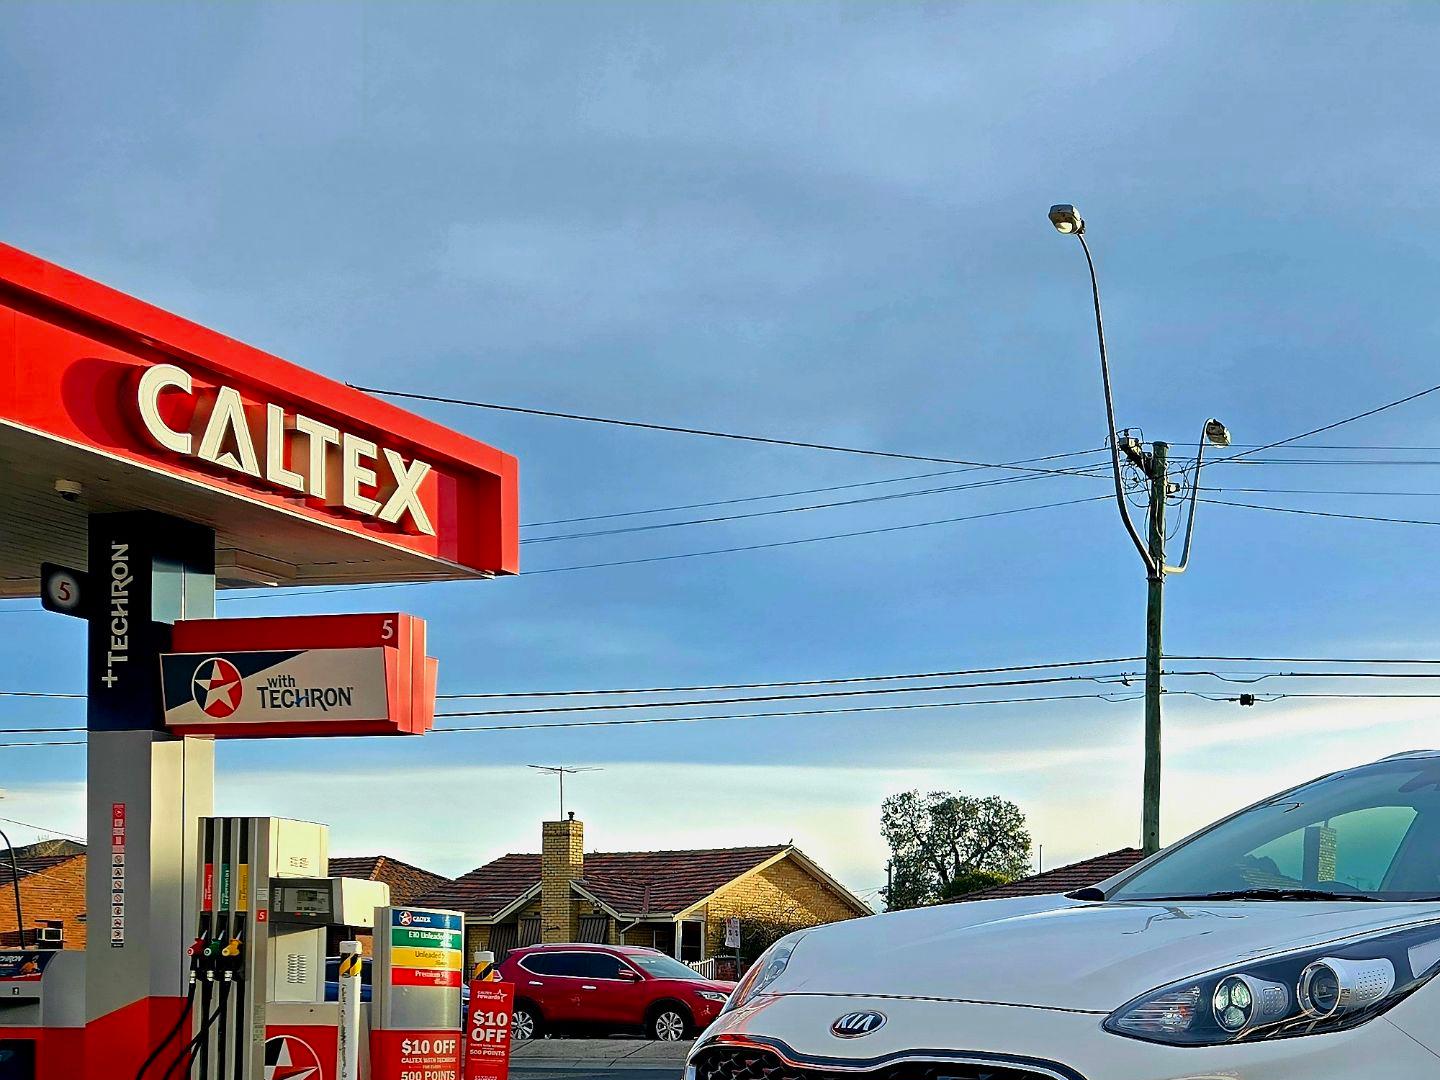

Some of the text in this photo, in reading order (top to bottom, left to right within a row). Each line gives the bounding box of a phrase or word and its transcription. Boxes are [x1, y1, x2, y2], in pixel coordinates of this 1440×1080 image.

[137, 363, 436, 537] CALTEX
[58, 581, 71, 601] 5
[381, 619, 394, 640] 5
[266, 674, 296, 688] with
[256, 686, 354, 712] TECHRON
[472, 1009, 508, 1027] $10
[834, 1013, 875, 1030] KIA
[471, 1027, 508, 1043] OFF
[401, 1037, 456, 1056] $10 OFF
[482, 1049, 506, 1057] POINTS
[424, 1070, 456, 1080] POINTS
